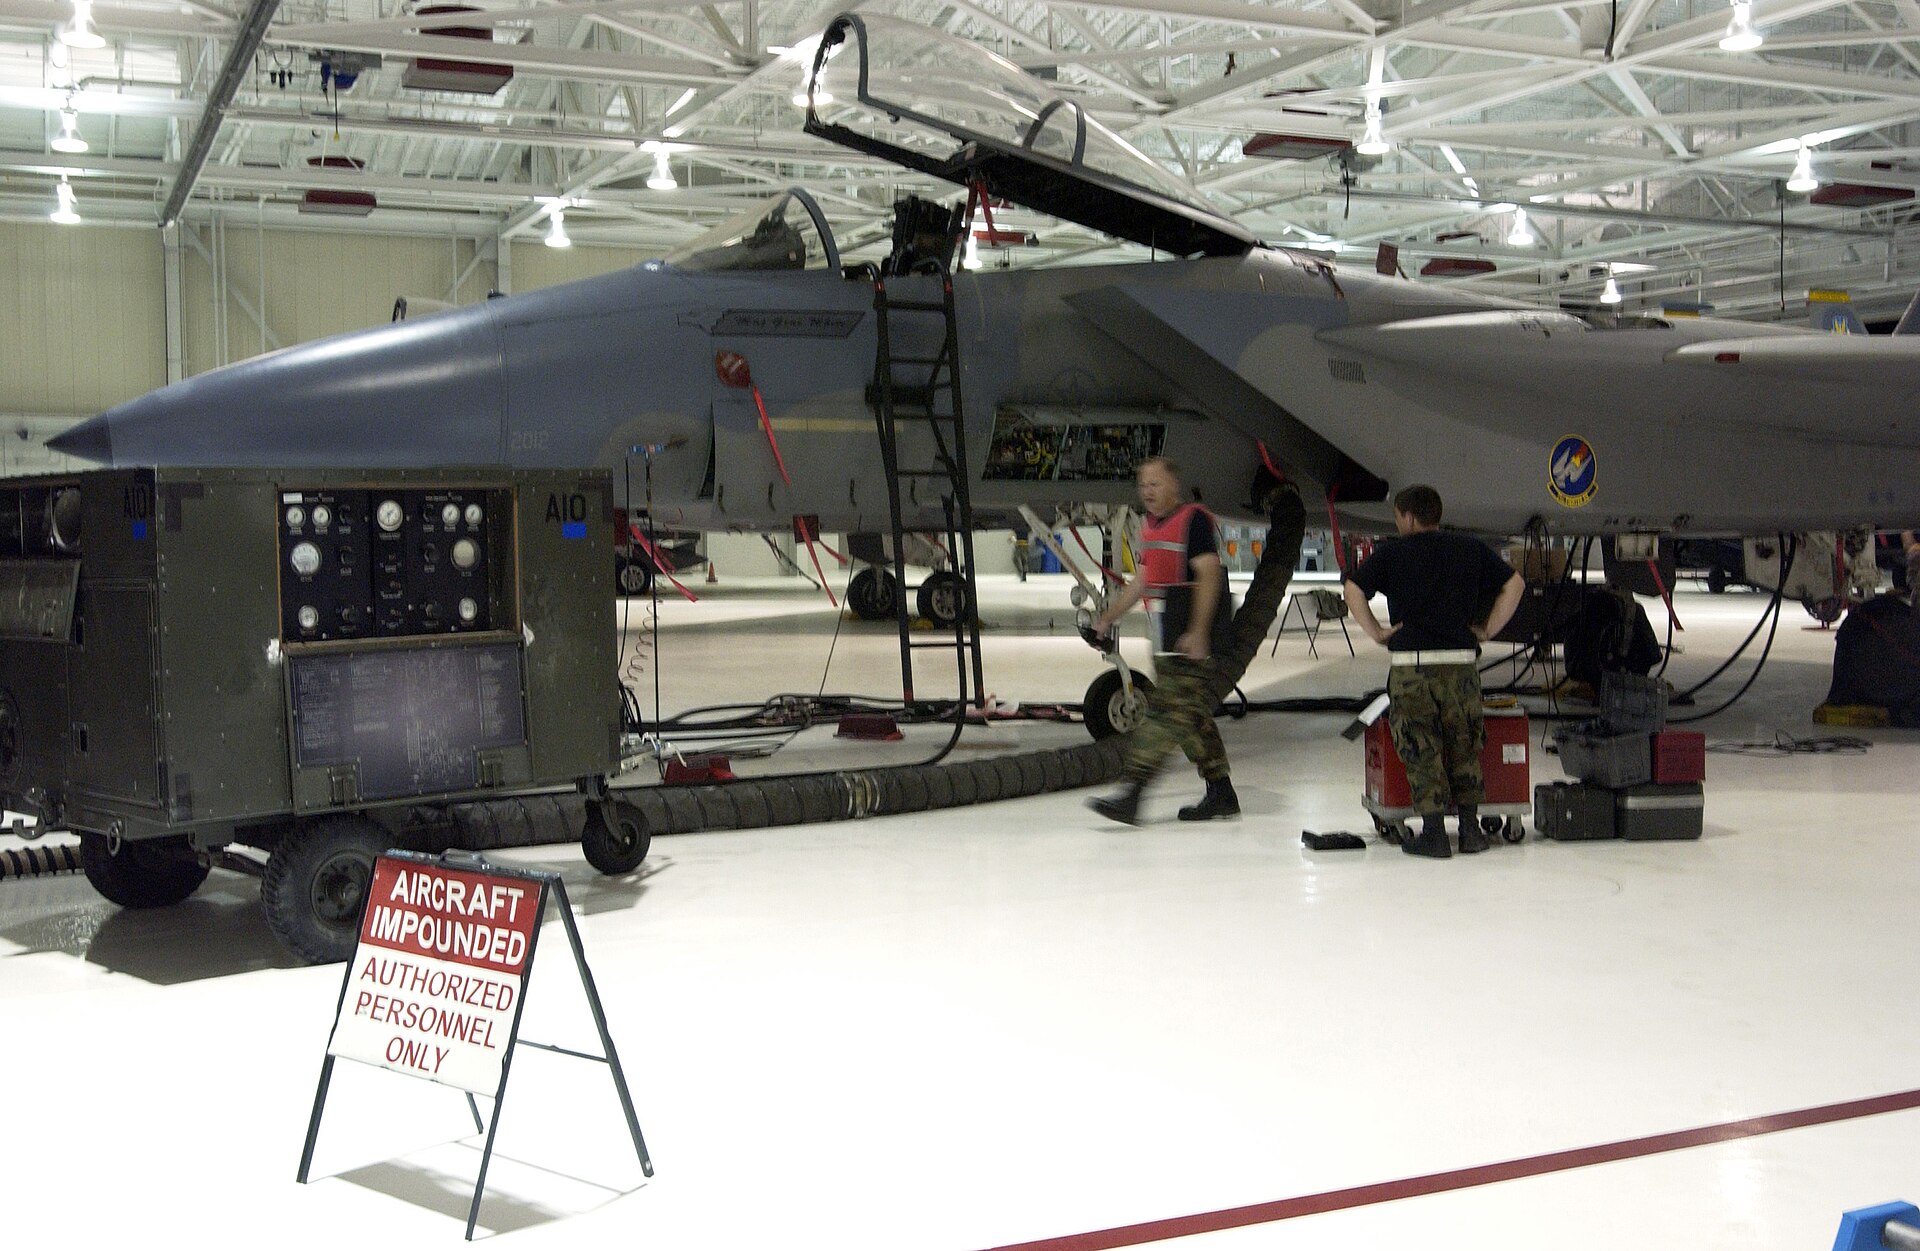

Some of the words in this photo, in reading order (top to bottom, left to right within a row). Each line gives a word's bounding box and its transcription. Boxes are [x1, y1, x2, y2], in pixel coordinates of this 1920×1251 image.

[510, 430, 550, 451] 2012
[390, 869, 524, 923] AIRCRAFT
[369, 904, 527, 967] IMPOUNDED
[360, 956, 515, 1013] AUTHORIZED
[354, 990, 497, 1050] PERSONNEL
[385, 1036, 450, 1075] ONLY
